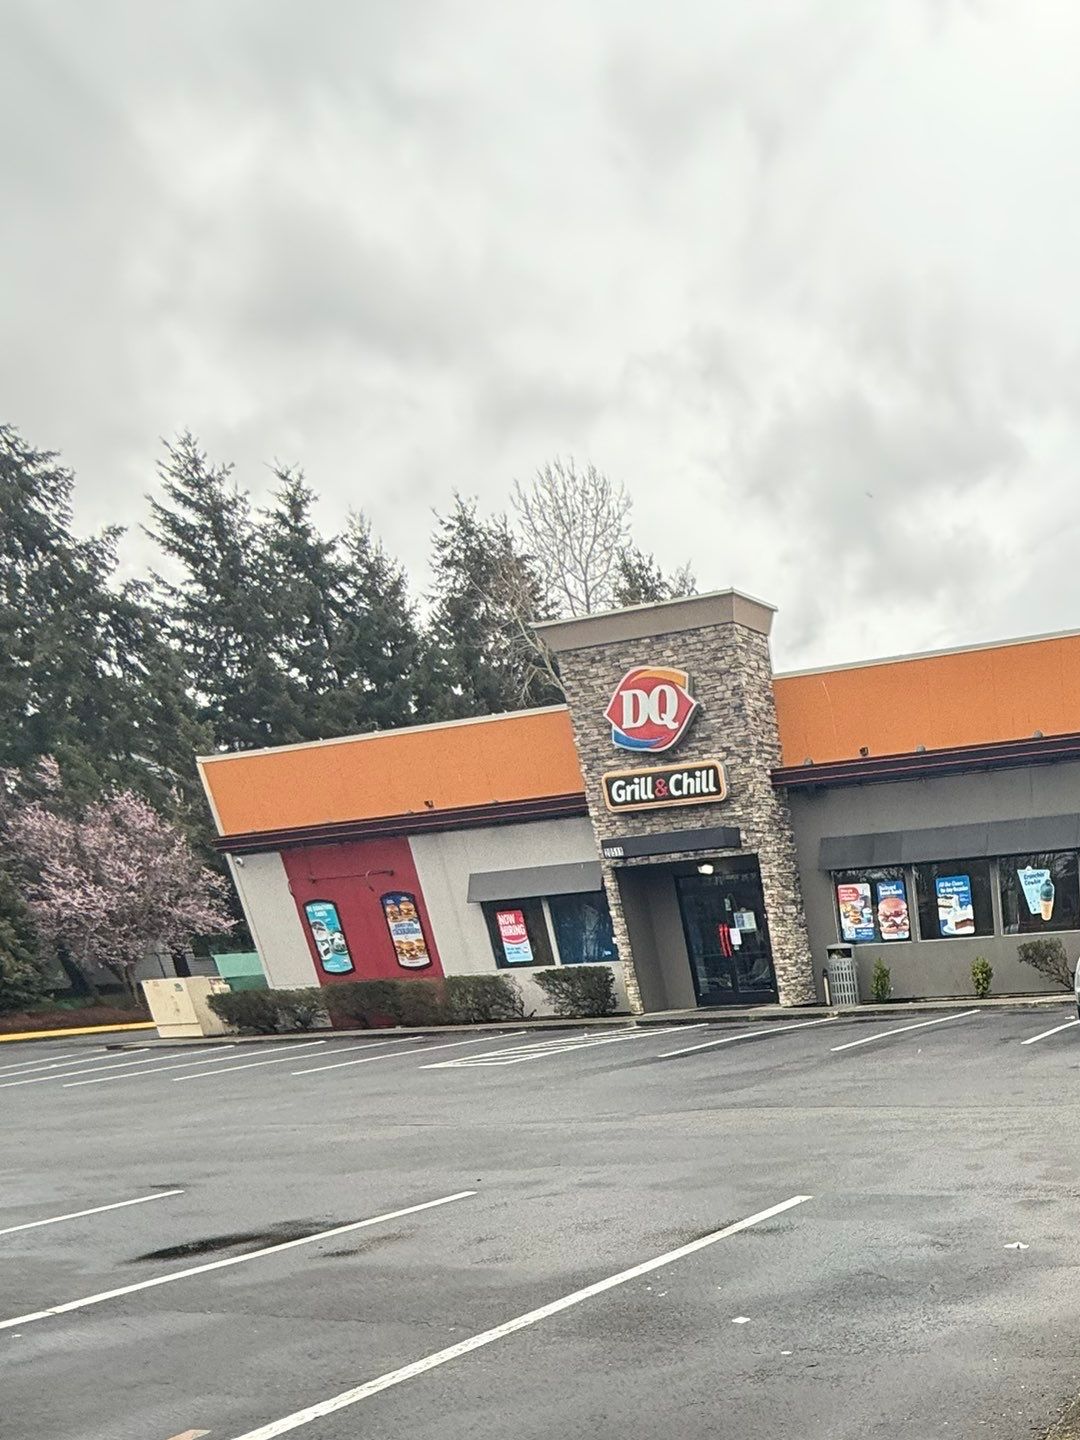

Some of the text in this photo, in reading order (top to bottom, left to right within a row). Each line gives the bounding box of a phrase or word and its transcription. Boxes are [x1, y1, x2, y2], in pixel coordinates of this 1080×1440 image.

[619, 684, 680, 730] DQ
[497, 913, 516, 926] NOW
[499, 924, 527, 937] HIRING
